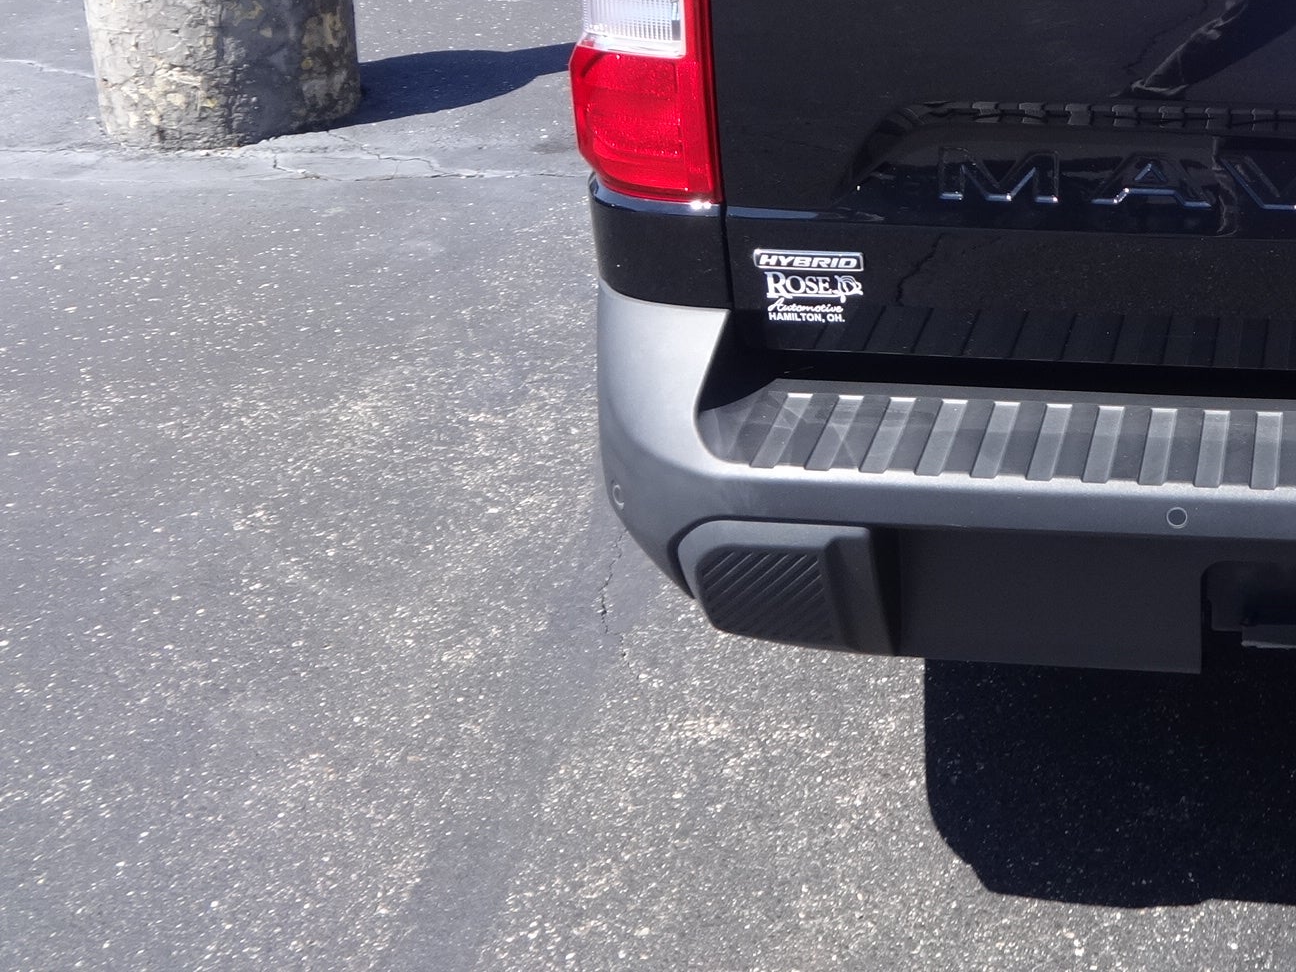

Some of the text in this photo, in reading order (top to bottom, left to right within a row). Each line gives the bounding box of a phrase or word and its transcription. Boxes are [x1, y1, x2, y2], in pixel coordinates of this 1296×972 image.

[759, 254, 858, 269] HYBRID
[764, 271, 834, 299] ROSE
[767, 297, 844, 313] Automotive
[768, 312, 846, 323] HAMILTON, OH.
